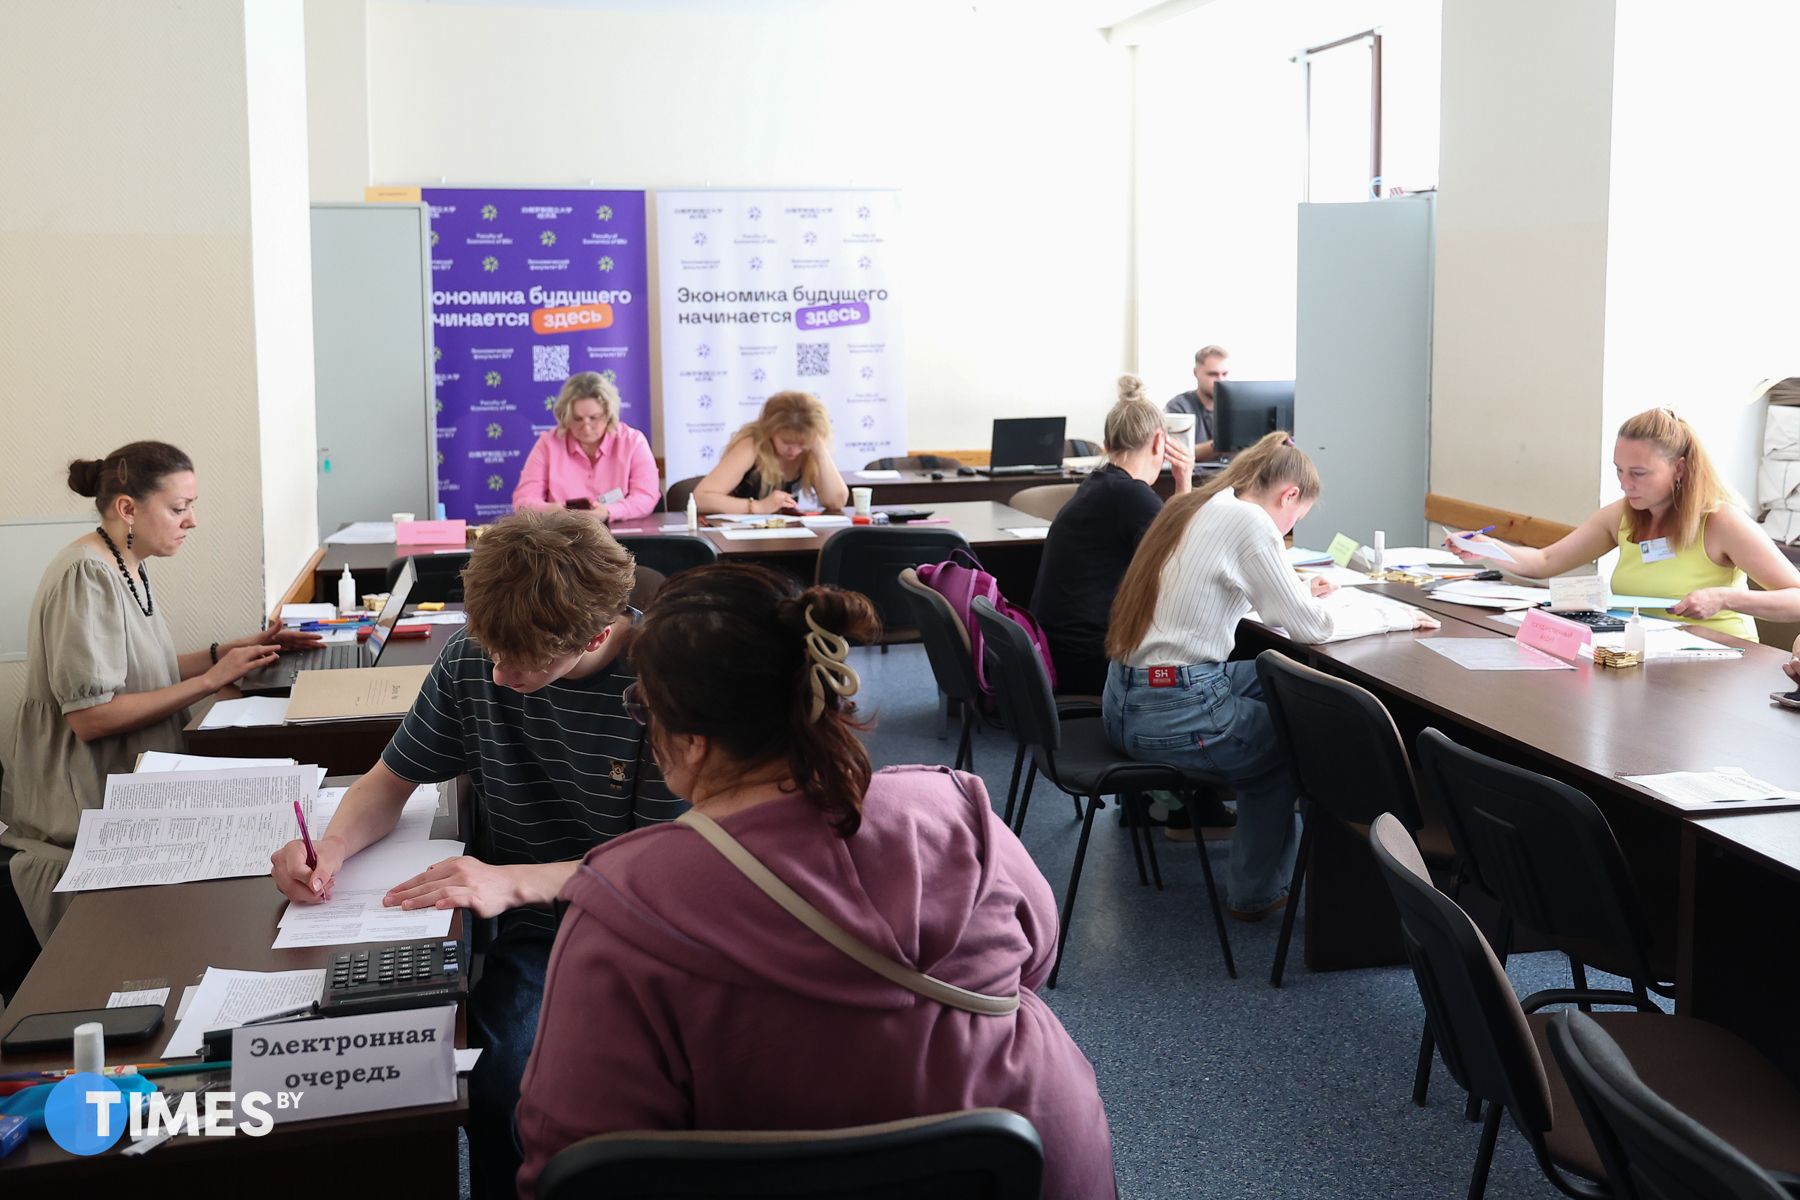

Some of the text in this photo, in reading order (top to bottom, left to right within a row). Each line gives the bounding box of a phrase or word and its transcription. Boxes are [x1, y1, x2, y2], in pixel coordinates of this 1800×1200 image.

[433, 285, 632, 308] ономика будущего
[677, 285, 888, 306] Экономика будущего
[433, 310, 602, 329] чинается здесь
[678, 308, 861, 327] начинается здесь
[250, 1028, 436, 1057] Электронная
[285, 1065, 401, 1089] очередь
